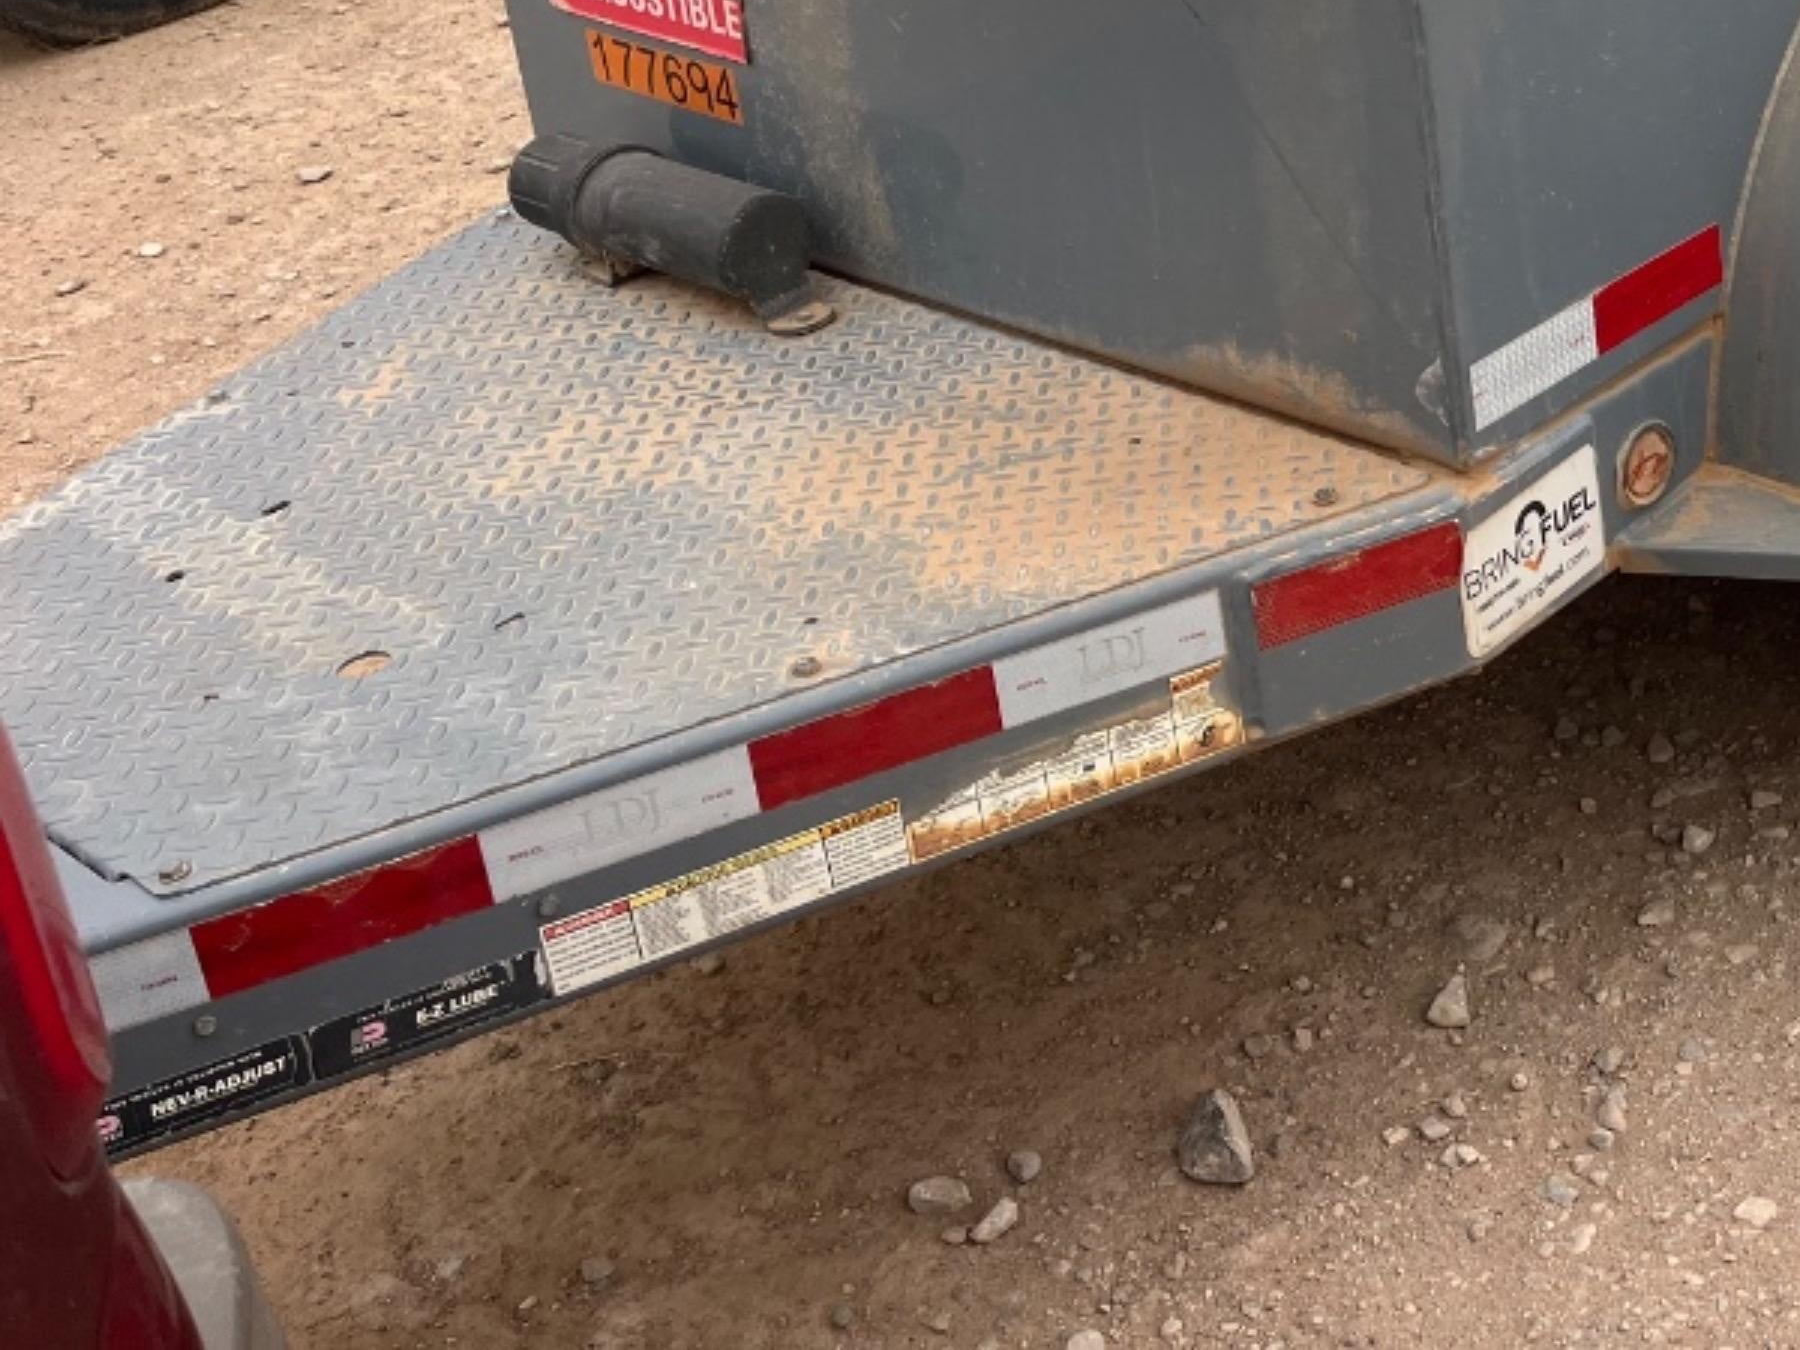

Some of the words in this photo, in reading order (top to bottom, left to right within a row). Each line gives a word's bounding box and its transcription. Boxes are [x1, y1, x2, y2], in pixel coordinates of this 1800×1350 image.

[593, 32, 740, 121] 177694
[1463, 528, 1534, 601] BRING
[1540, 486, 1597, 546] FUEL
[150, 1055, 287, 1118] NEV-R-ADJUST
